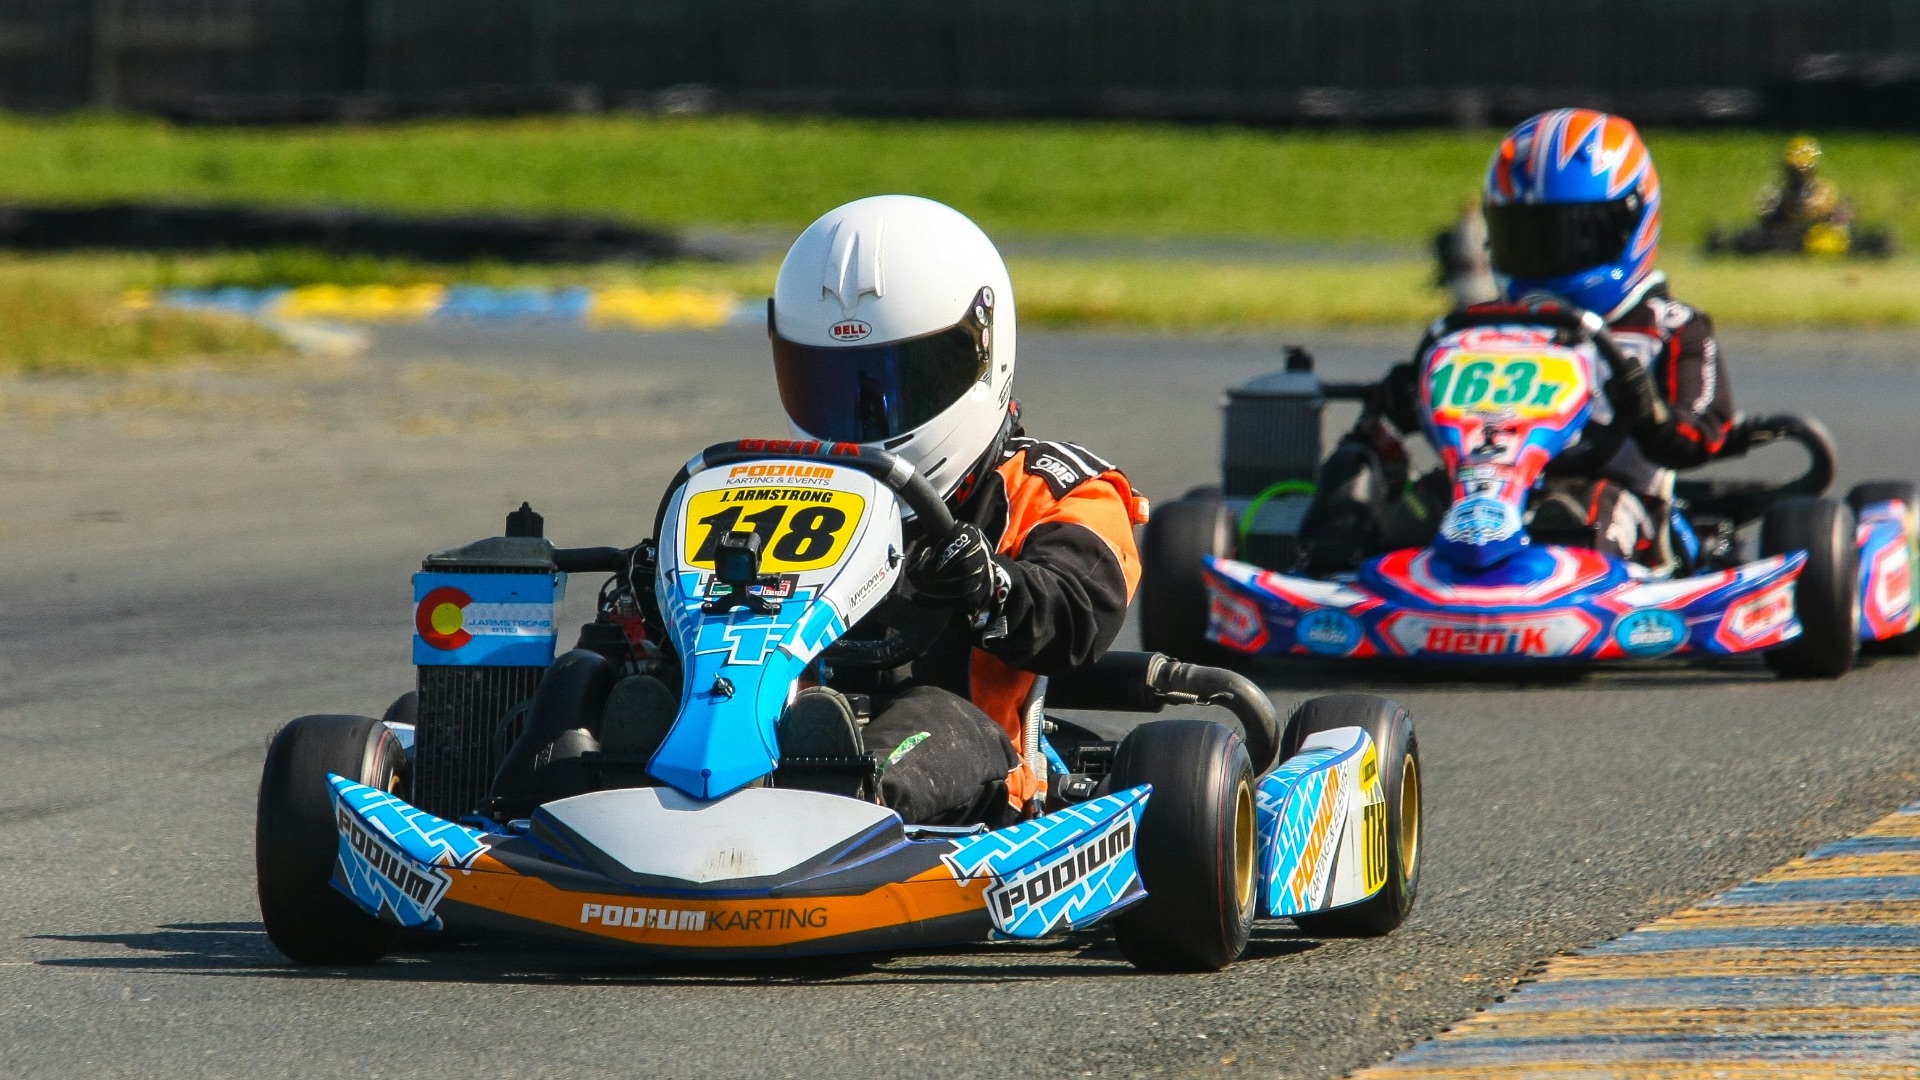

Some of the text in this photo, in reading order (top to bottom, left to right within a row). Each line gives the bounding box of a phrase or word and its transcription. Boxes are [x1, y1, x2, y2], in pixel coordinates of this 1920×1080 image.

[834, 324, 866, 335] BELL
[1430, 361, 1559, 408] 163x
[726, 476, 774, 486] KARTING
[788, 476, 831, 486] EVENTS
[729, 465, 835, 479] PODIUM
[1036, 457, 1076, 483] OMP
[719, 489, 834, 503] J. ARMSTRONG
[691, 505, 846, 563] 118
[338, 807, 435, 905] PODIUM
[1292, 766, 1340, 911] PODIUM
[998, 821, 1131, 920] PODIUM
